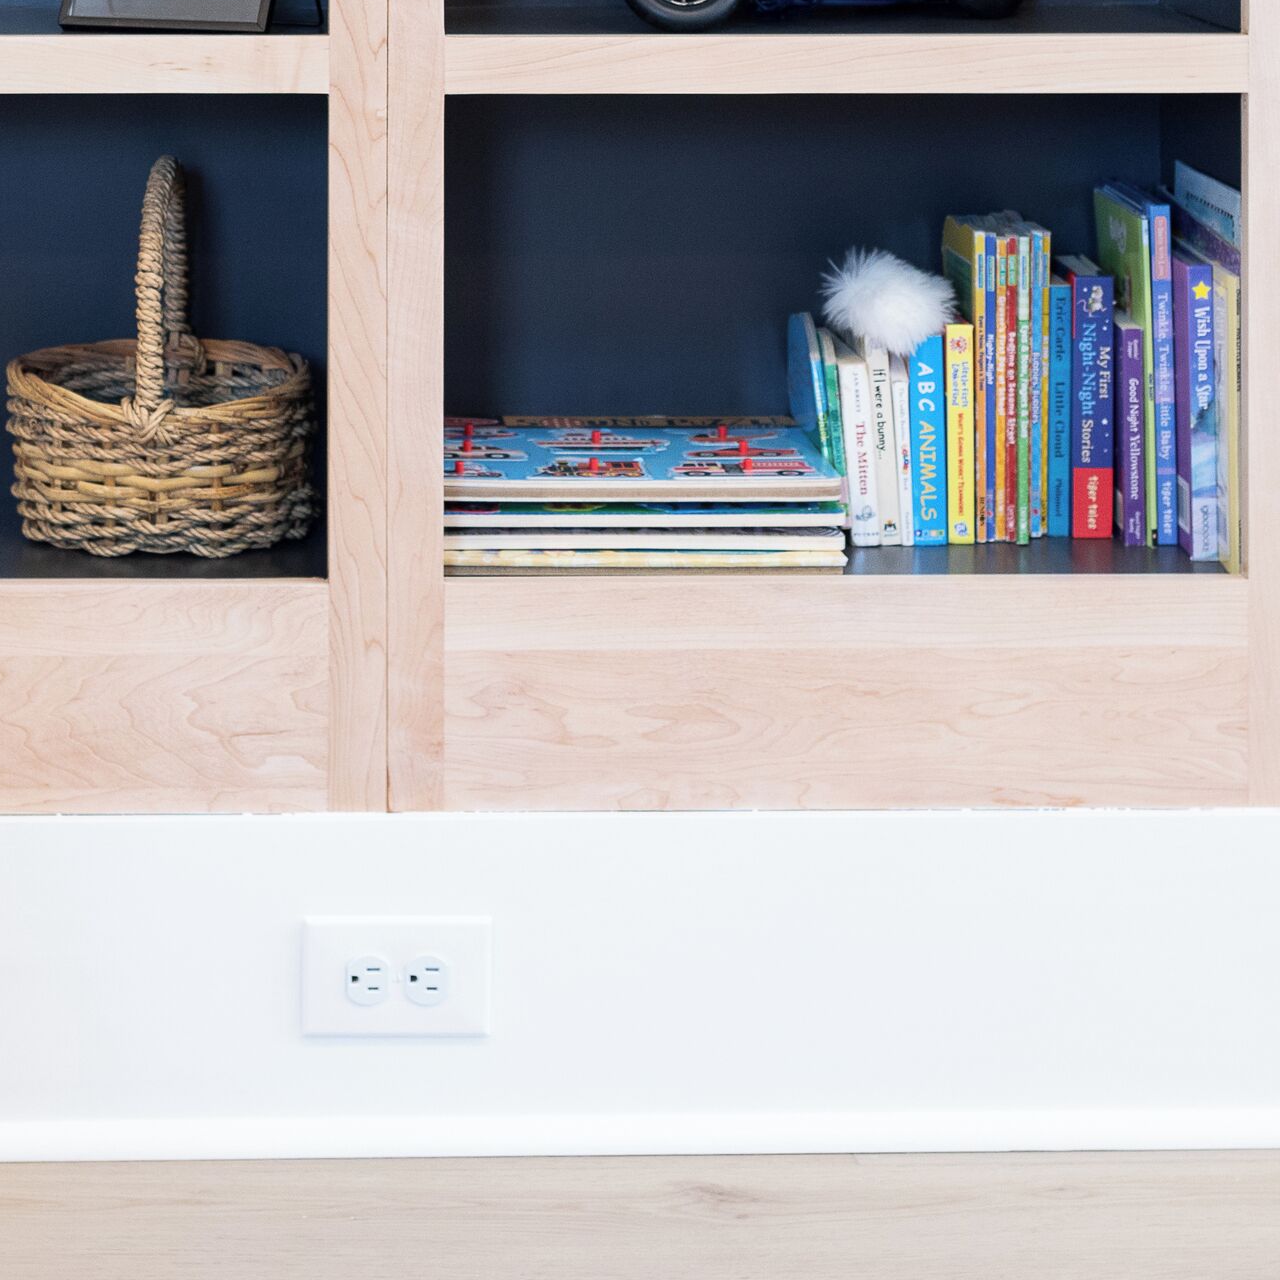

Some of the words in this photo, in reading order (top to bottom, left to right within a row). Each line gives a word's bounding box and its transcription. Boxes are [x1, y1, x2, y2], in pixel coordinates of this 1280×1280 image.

[1055, 297, 1066, 322] Eric
[1157, 293, 1168, 342] Twinkle,
[1194, 306, 1211, 336] Wish
[1055, 327, 1066, 361] Carle
[1098, 347, 1111, 368] My
[1194, 340, 1211, 370] Upon
[1079, 323, 1097, 416] Night-Night
[1158, 345, 1170, 394] Twinkle,
[1198, 373, 1206, 381] a
[875, 385, 883, 408] were
[1008, 383, 1016, 415] Sesame
[1055, 382, 1066, 418] Little
[1099, 371, 1111, 399] First
[1128, 378, 1139, 403] Good
[1196, 385, 1211, 410] Star
[1127, 405, 1140, 431] Night
[1160, 398, 1171, 427] Little
[855, 422, 866, 447] The
[1055, 421, 1066, 458] Cloud
[1081, 420, 1094, 463] Stories
[1159, 430, 1171, 460] Baby
[857, 451, 869, 495] Mitten
[918, 421, 938, 521] ANIMALS
[1129, 434, 1141, 500] Yellowstone
[1087, 475, 1099, 502] tiger
[1088, 504, 1099, 531] tales
